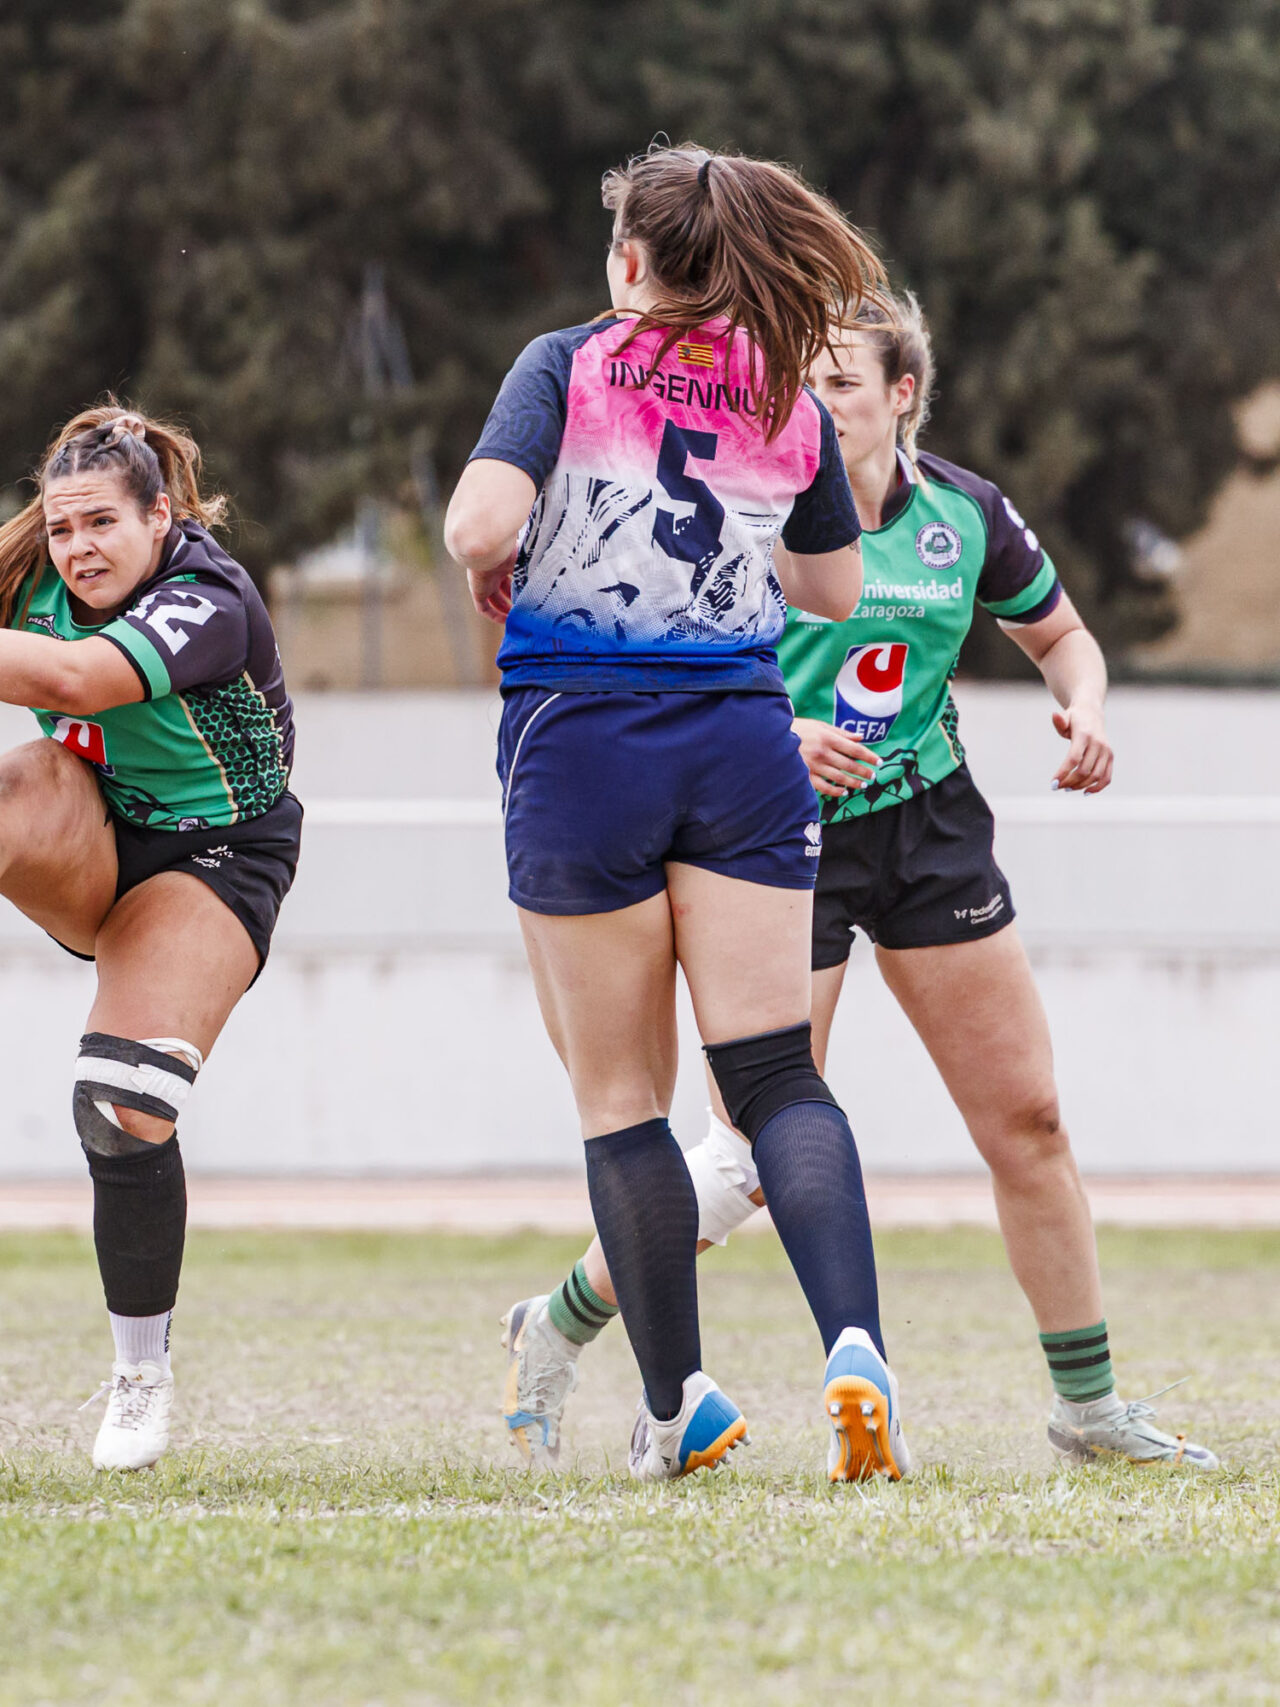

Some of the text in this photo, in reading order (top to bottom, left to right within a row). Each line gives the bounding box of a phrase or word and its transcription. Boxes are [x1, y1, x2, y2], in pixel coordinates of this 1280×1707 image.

[610, 361, 776, 419] INGENNU
[652, 418, 725, 564] 5
[862, 576, 963, 600] niversidad
[840, 719, 887, 740] CEFA
